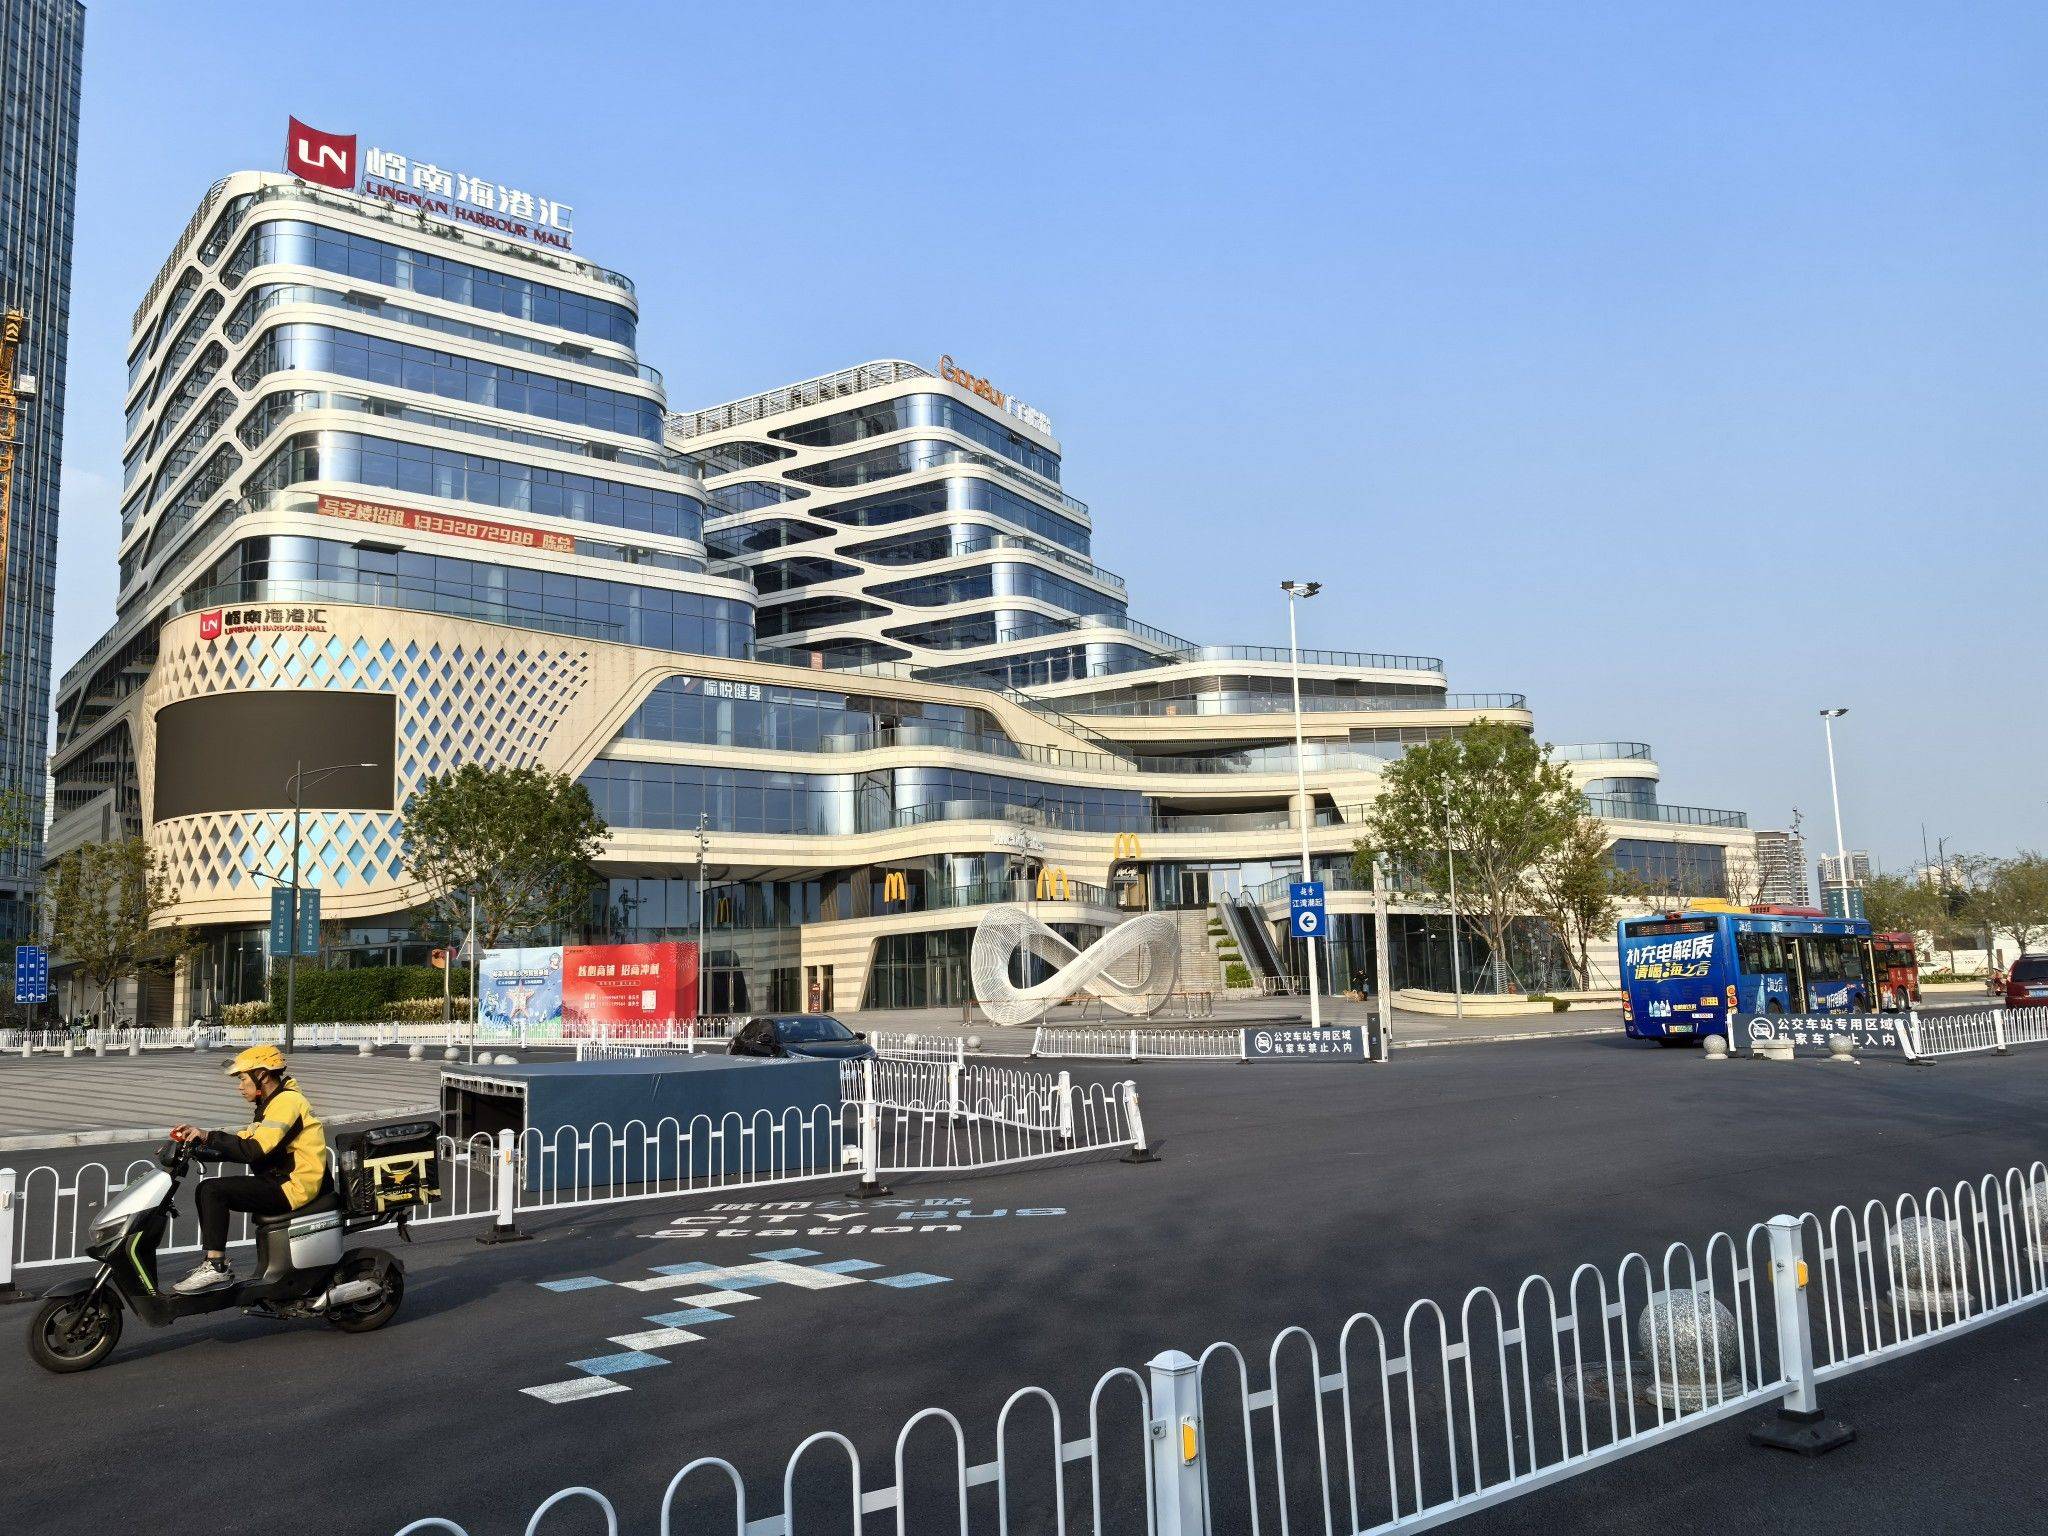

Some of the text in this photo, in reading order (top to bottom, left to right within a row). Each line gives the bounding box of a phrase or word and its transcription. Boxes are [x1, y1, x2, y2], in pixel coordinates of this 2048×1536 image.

[298, 138, 347, 175] LN
[366, 147, 574, 234] 岭南海港汇
[366, 181, 572, 250] LINGNAN HARBOUR MALL
[324, 499, 405, 527] 写字楼招租
[413, 514, 534, 545] 13332872988
[224, 608, 327, 626] 岭南海港汇
[703, 680, 762, 701] 愉悦健身
[1626, 933, 1715, 967] 补充电解质
[1777, 1017, 1895, 1031] 公交车站专用区域
[1274, 1029, 1352, 1042] 公交车站专用区域
[1274, 1042, 1353, 1054] 私家车禁止入内
[669, 1207, 1068, 1225] CITY BUS
[642, 1224, 963, 1239] Station
